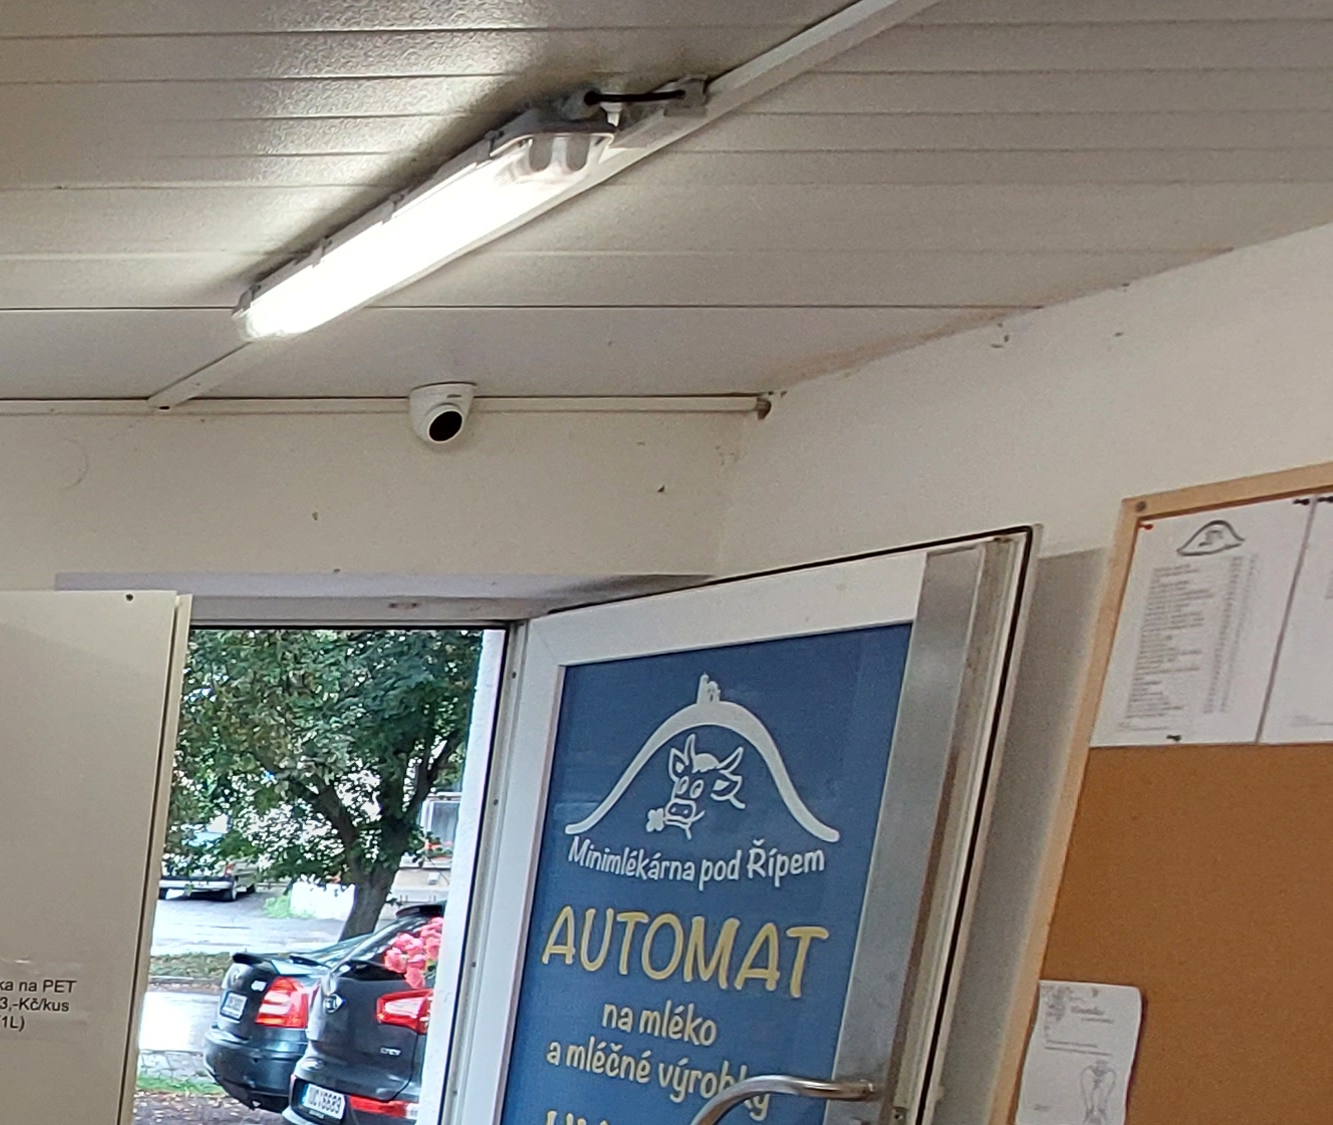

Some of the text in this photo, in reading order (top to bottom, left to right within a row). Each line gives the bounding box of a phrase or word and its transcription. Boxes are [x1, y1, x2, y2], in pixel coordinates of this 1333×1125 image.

[567, 835, 826, 891] Minimlékárna pod Řípem
[541, 905, 830, 998] AUTOMAT
[18, 981, 37, 992] na
[42, 979, 78, 994] PET
[601, 1000, 718, 1047] na mléko
[546, 1043, 562, 1066] a
[565, 1036, 652, 1084] mléčné
